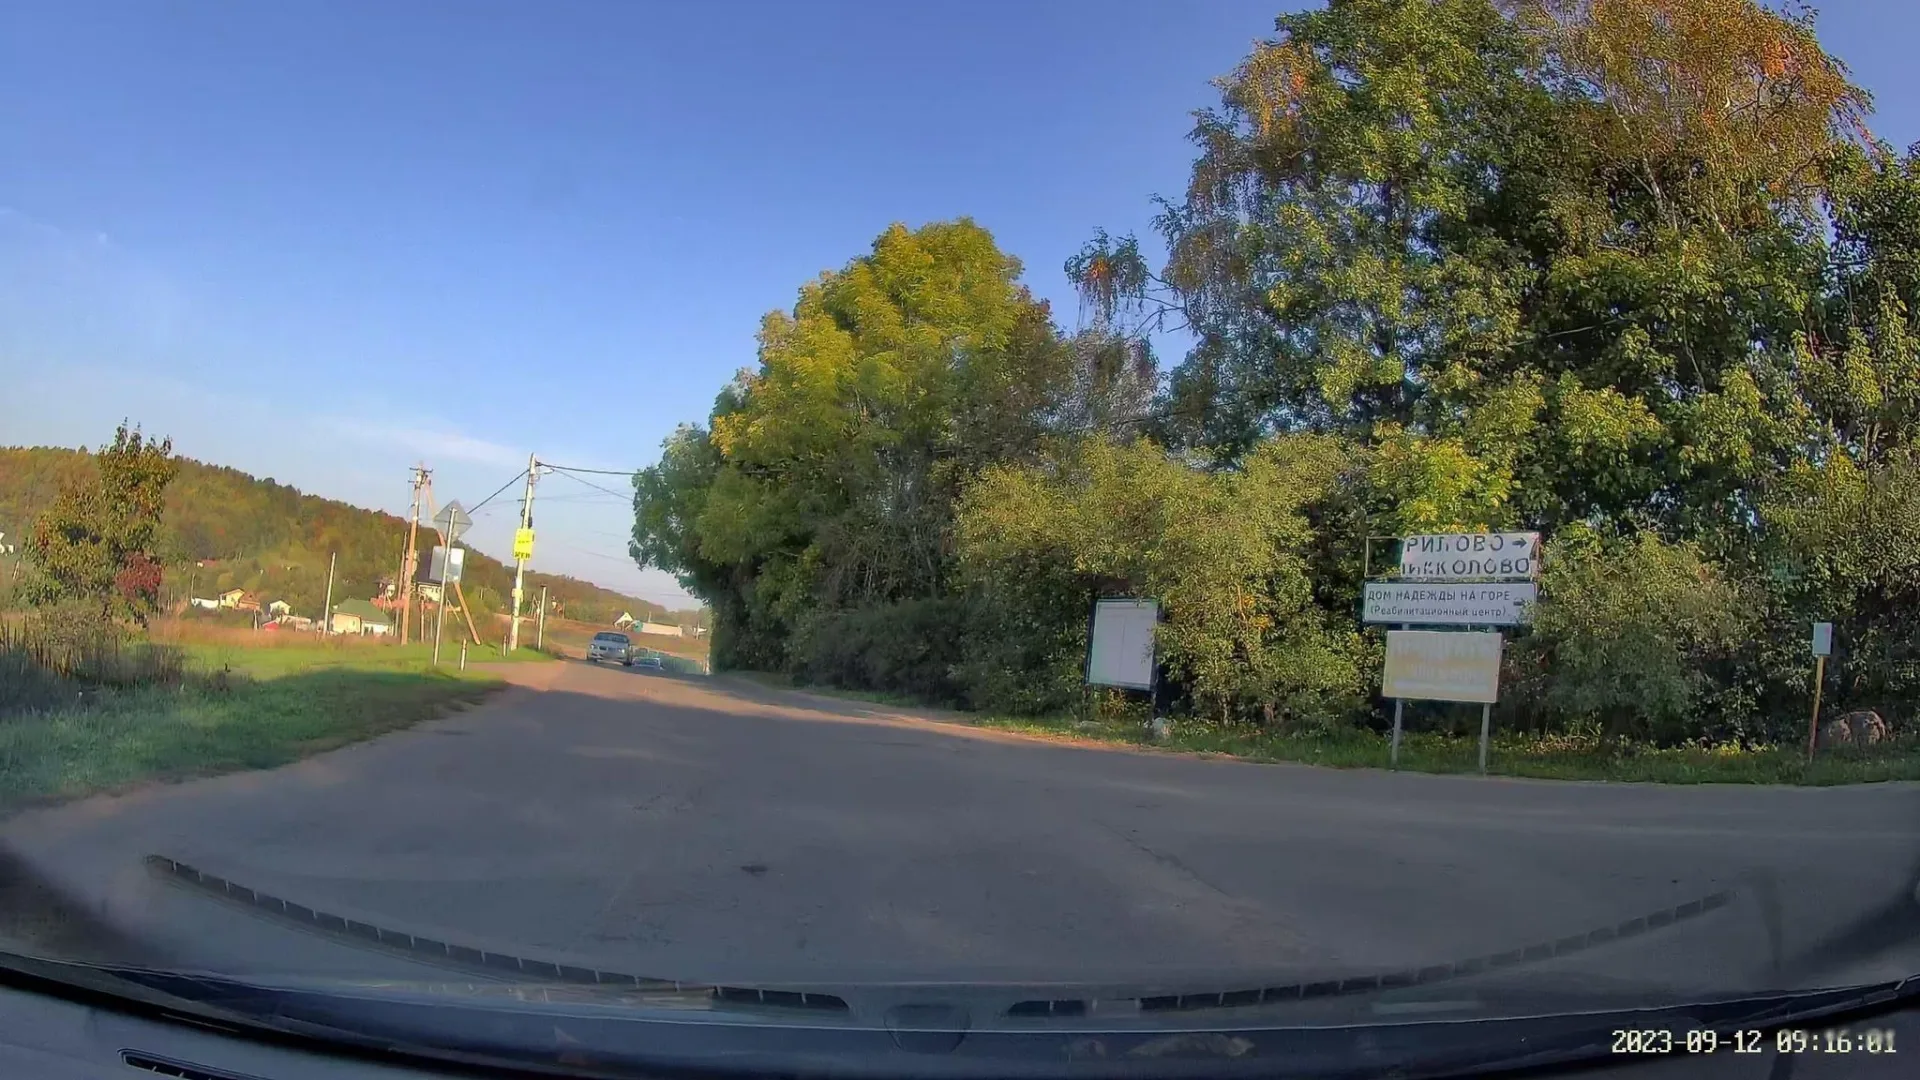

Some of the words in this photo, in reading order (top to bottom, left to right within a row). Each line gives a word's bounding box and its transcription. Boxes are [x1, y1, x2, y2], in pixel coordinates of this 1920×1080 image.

[1367, 590, 1392, 602] ДОМ
[1395, 590, 1456, 602] НАДЕЖДЫ
[1460, 590, 1476, 601] НА
[1480, 590, 1511, 601] ГОРЕ
